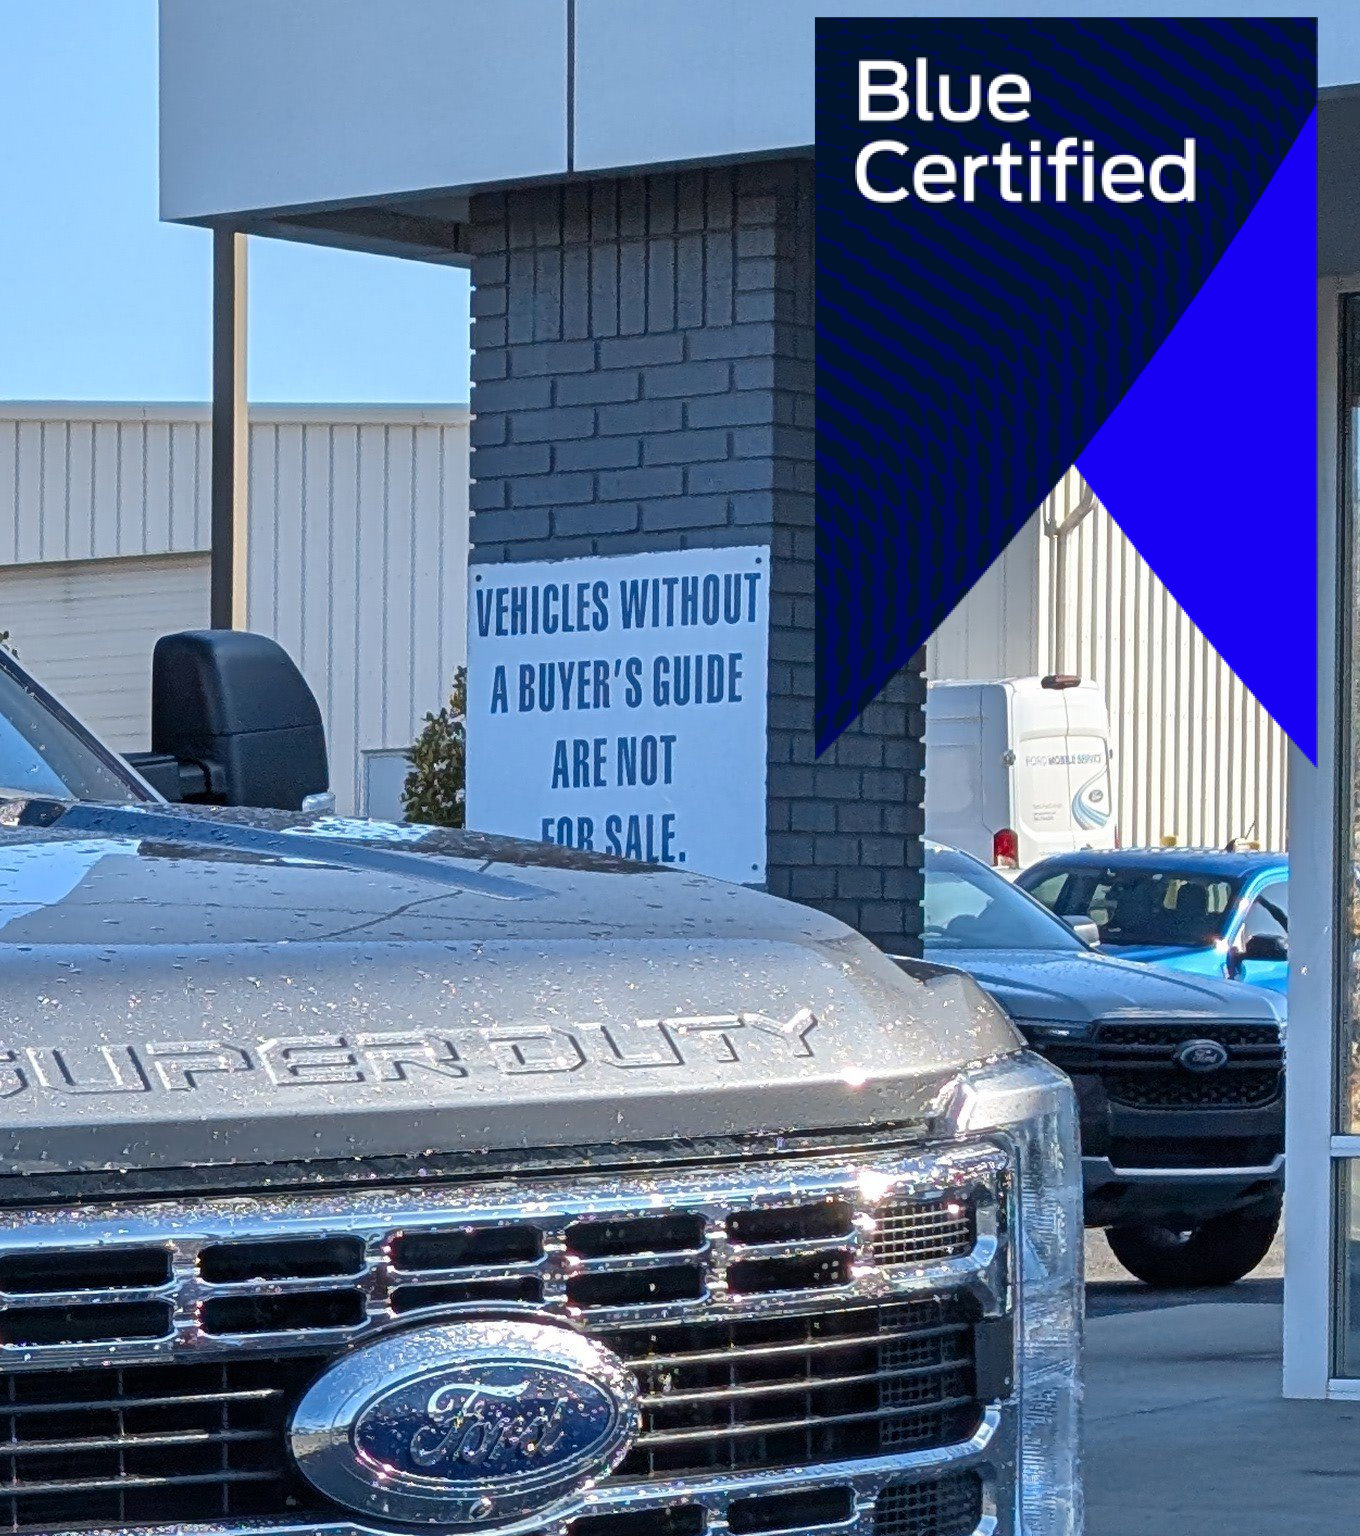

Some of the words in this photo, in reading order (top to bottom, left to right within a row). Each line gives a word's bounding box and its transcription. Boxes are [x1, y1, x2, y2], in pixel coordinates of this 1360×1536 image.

[476, 580, 609, 636] VEHICLES
[619, 572, 762, 629] WITHOUT
[490, 665, 509, 714] A
[518, 656, 643, 712] BUYER'S
[653, 653, 743, 706] GUIDE
[551, 738, 607, 789] ARE
[617, 734, 677, 786] NOT
[605, 813, 687, 863] SALE.
[484, 1007, 819, 1077] DUTY
[410, 1382, 566, 1467] Ford
